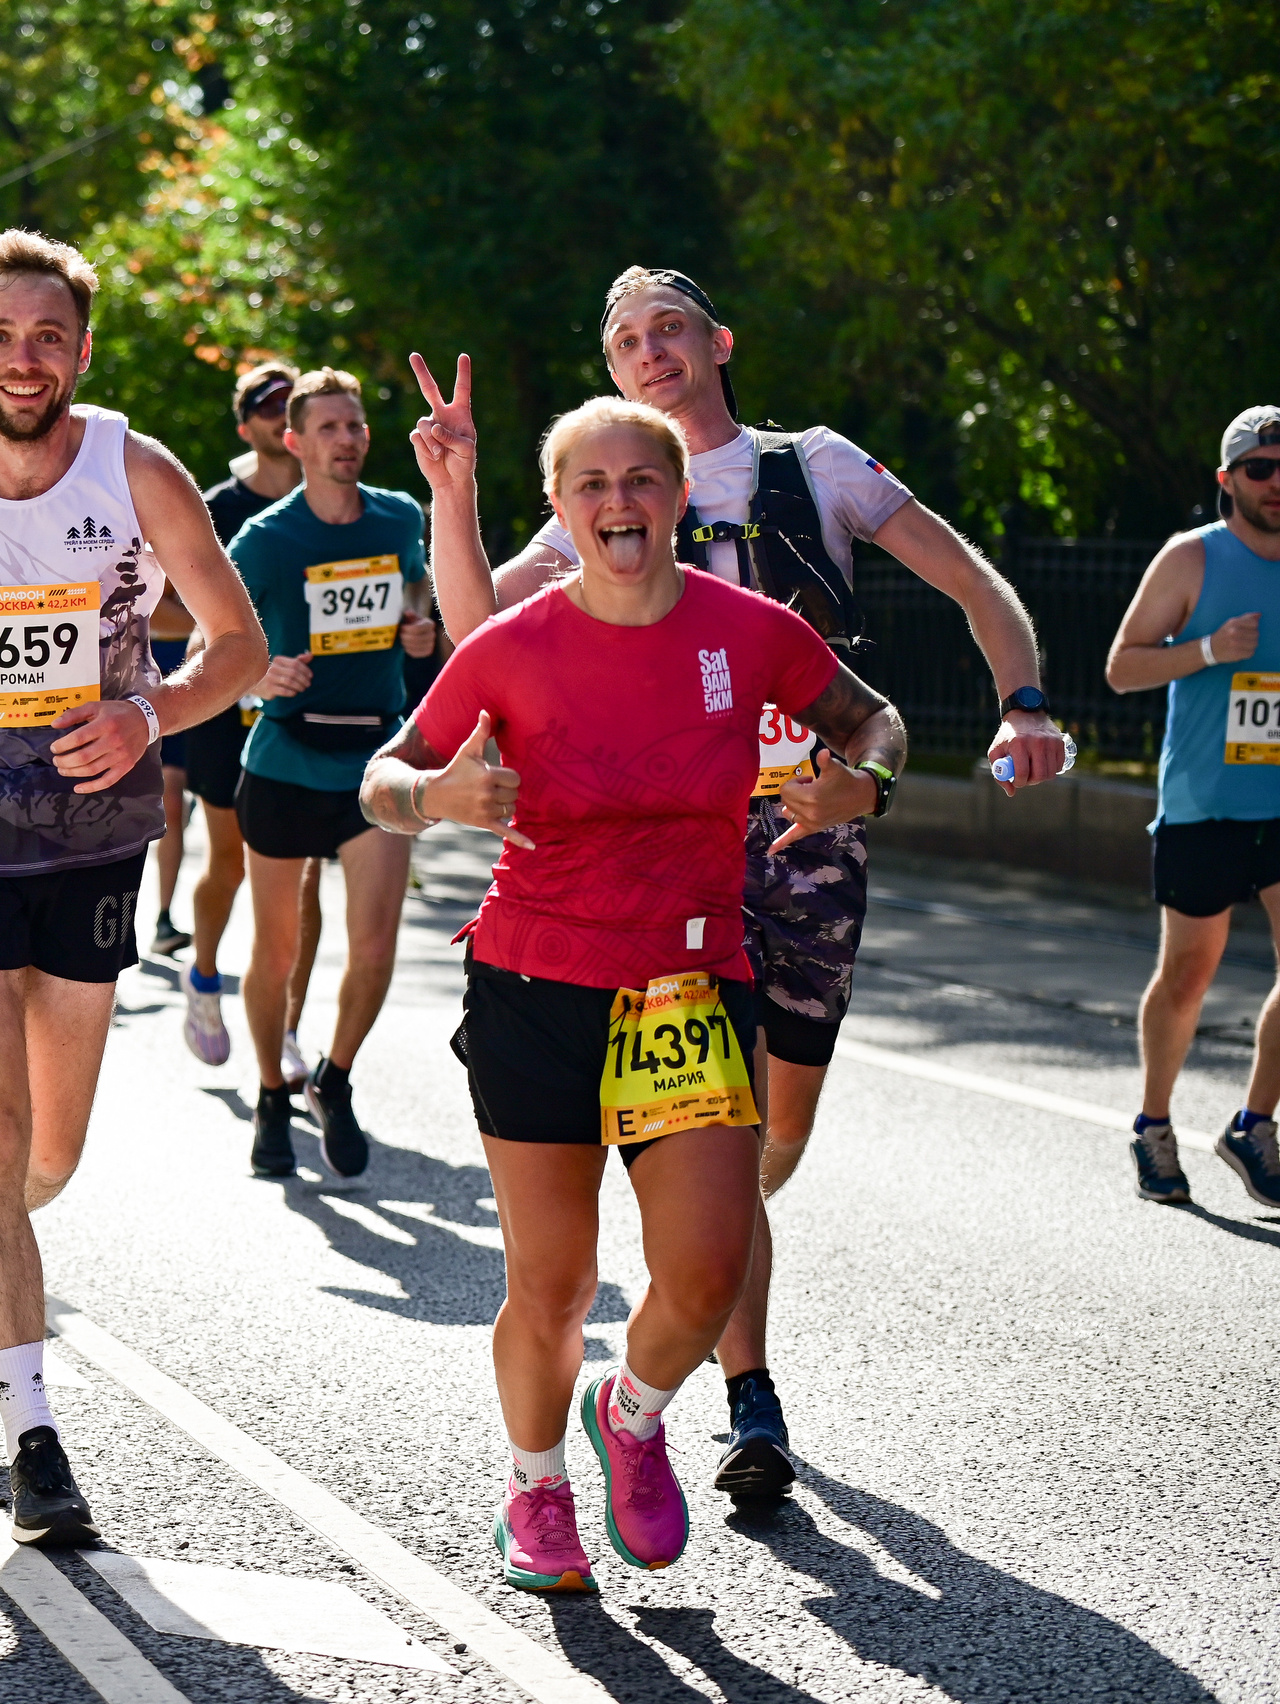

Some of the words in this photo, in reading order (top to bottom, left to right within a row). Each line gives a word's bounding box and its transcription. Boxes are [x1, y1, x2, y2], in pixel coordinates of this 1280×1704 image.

[47, 598, 69, 609] 42,2
[70, 597, 86, 607] КМ
[322, 582, 390, 616] 3947
[698, 648, 729, 675] Sat
[0, 672, 44, 685] РОМАН
[702, 670, 732, 694] 9AM
[134, 697, 154, 718] 2659
[704, 689, 733, 713] 5KM
[611, 1015, 731, 1079] 14397
[653, 1070, 706, 1092] МАРИЯ
[617, 1109, 636, 1137] E
